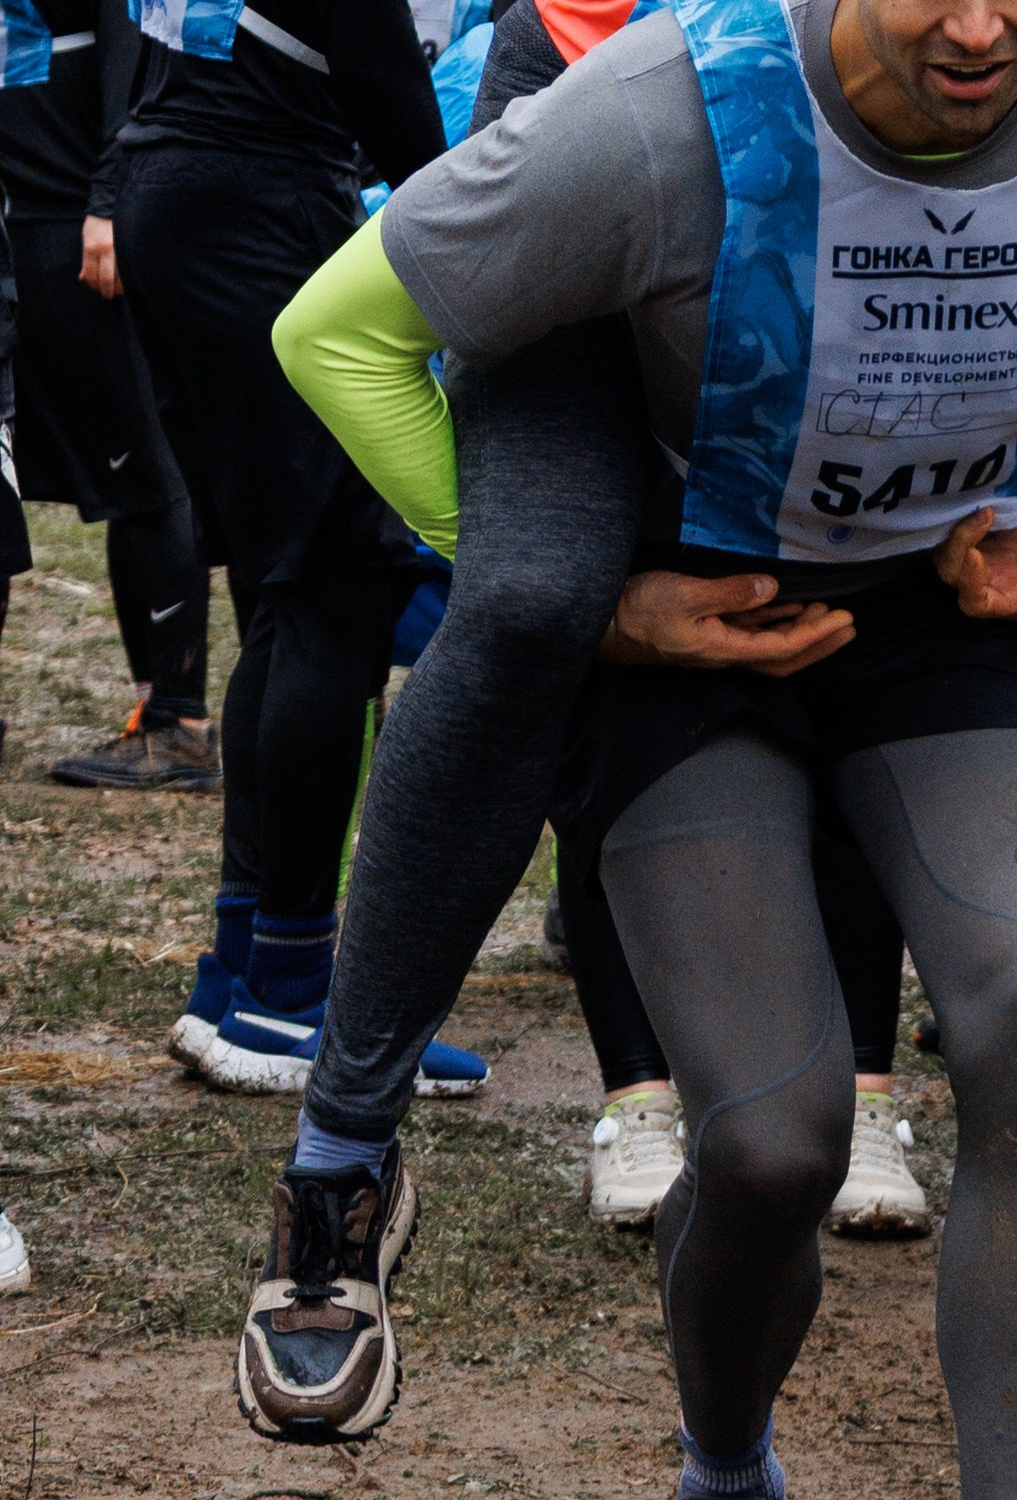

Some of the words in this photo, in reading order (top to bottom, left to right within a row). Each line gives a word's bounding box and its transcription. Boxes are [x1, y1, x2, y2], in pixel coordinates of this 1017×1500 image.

[832, 245, 934, 270] ГОНКА
[857, 371, 893, 384] FINE
[901, 367, 1017, 384] DEVELOPMENT
[810, 443, 1007, 517] 5410
